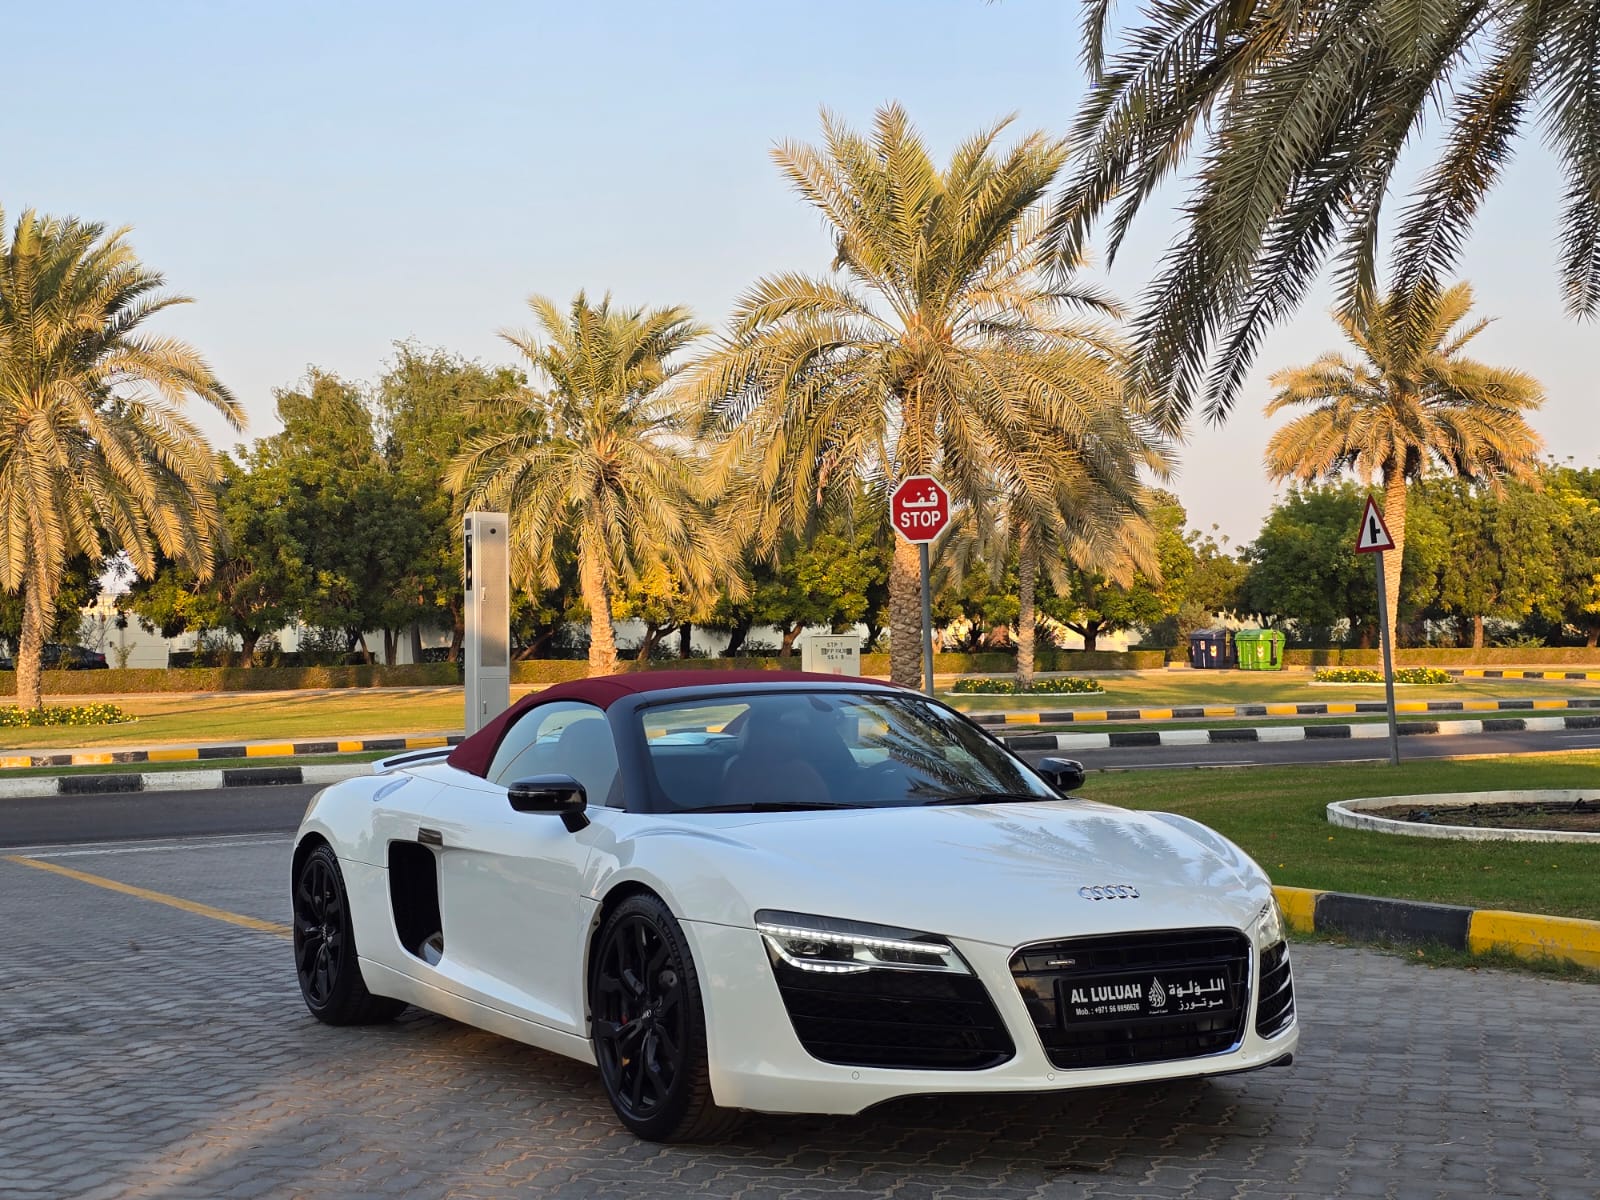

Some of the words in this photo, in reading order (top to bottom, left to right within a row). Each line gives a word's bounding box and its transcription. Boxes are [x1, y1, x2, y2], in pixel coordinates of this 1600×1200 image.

[902, 486, 938, 508] قف
[900, 511, 941, 528] STOP
[1071, 988, 1089, 1004] AL
[1090, 983, 1142, 1002] LULUAH
[1168, 977, 1225, 998] اللؤلؤة
[1095, 1005, 1108, 1014] +971
[1178, 997, 1224, 1011] موتورز
